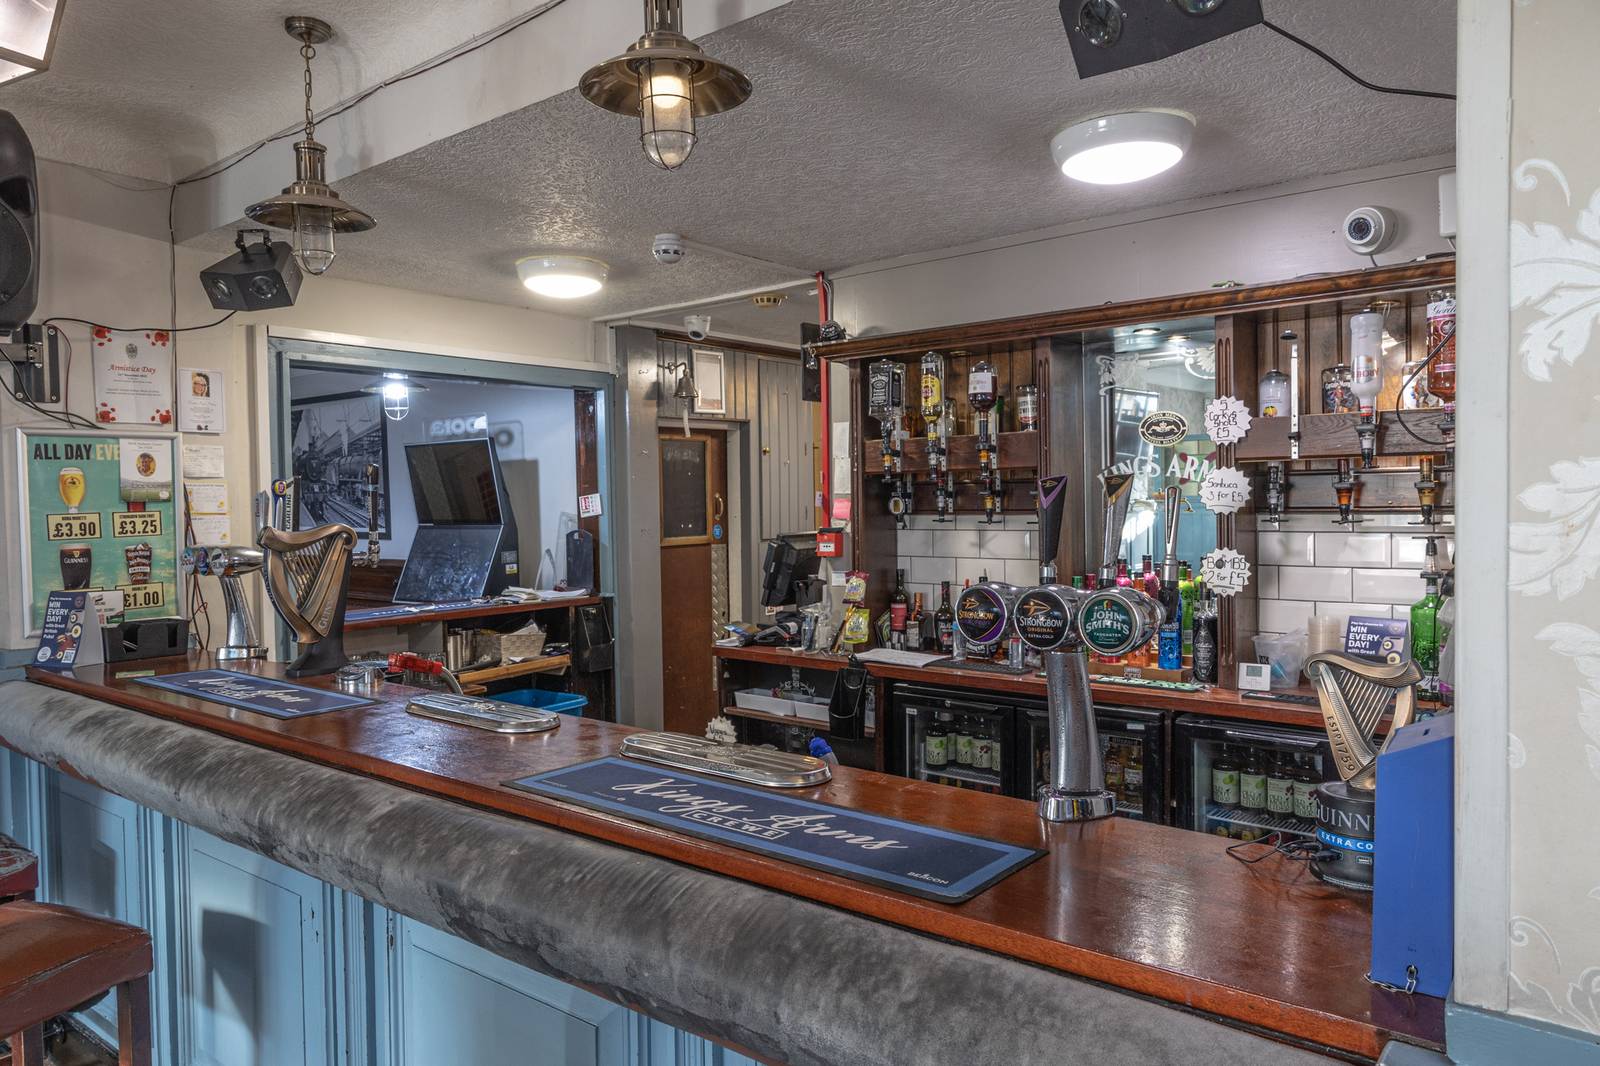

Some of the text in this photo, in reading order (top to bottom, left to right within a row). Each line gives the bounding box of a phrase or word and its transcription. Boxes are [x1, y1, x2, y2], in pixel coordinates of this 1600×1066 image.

[108, 364, 157, 375] Armistice Day
[1220, 400, 1229, 411] 5
[1216, 427, 1230, 439] £5
[33, 443, 61, 461] ALL
[64, 443, 93, 461] DAY
[1206, 492, 1215, 501] 3
[1231, 491, 1244, 503] £5
[52, 521, 96, 539] £3.90
[118, 519, 157, 536] £3.25
[1206, 570, 1215, 584] 2
[1229, 570, 1247, 587] £5
[123, 591, 160, 608] £1.00
[1019, 615, 1064, 628] STRONGBOW
[1090, 610, 1121, 621] JOHN
[1085, 618, 1130, 635] SMITH'S
[1350, 625, 1368, 634] WIN
[1348, 640, 1370, 649] DAY!
[1349, 632, 1380, 642] EVERY
[1335, 741, 1355, 773] 1759
[611, 778, 909, 850] Kings Arms
[1317, 799, 1376, 832] UINN
[692, 811, 781, 838] CREWE
[1320, 831, 1352, 847] EXTRA
